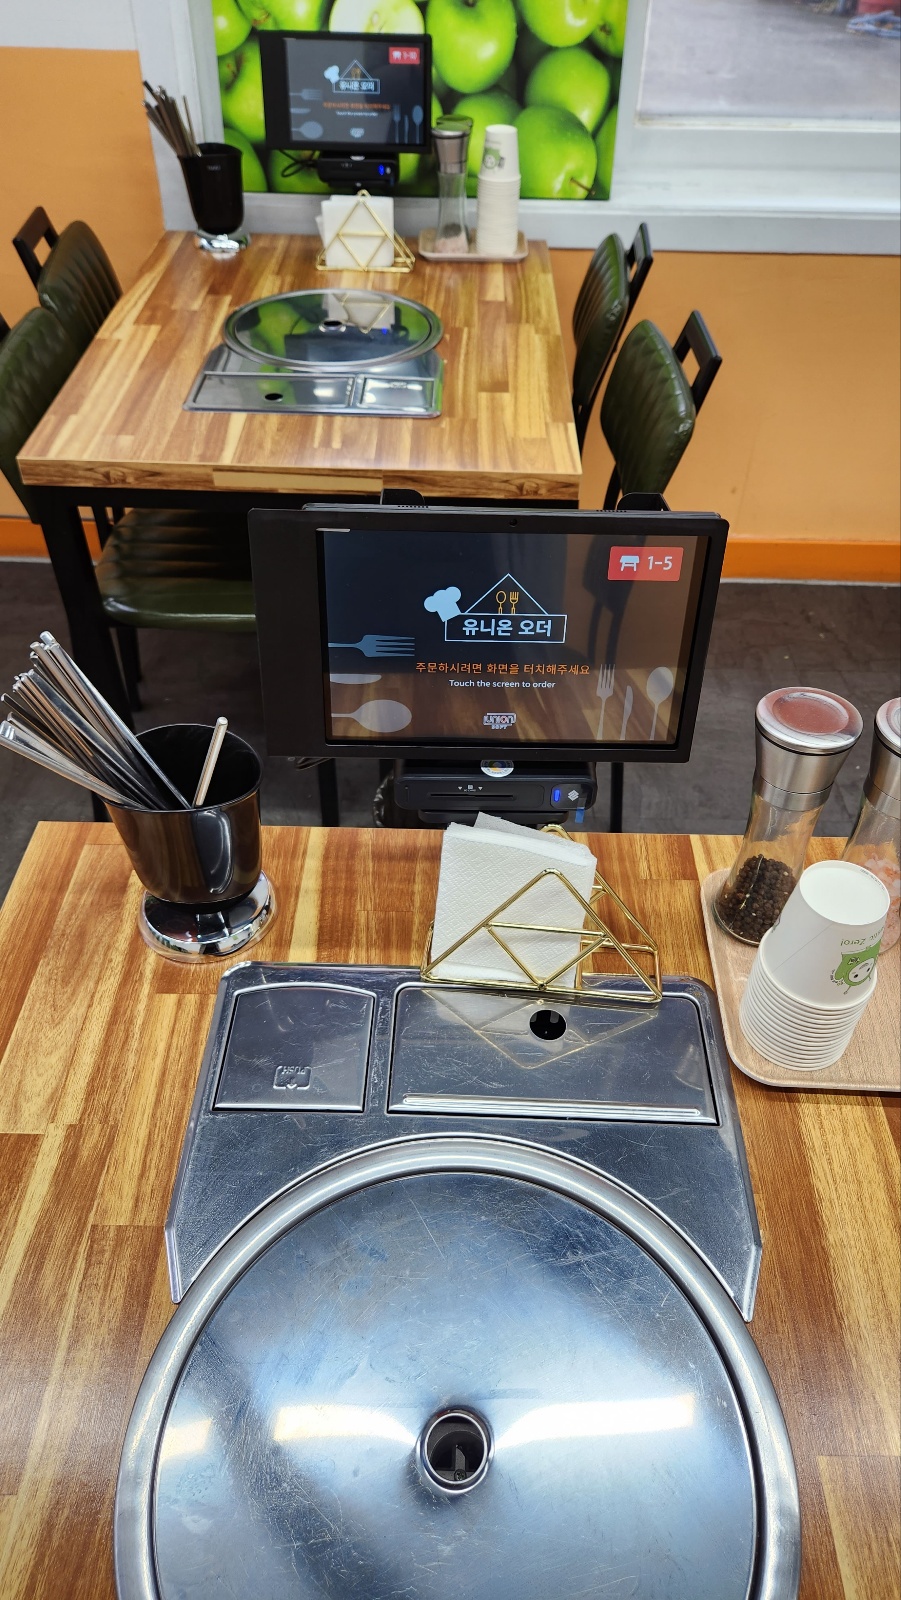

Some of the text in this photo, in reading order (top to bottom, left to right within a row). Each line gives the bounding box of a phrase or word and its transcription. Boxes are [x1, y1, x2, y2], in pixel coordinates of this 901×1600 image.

[647, 555, 673, 571] 1-5
[462, 618, 552, 637] 유니온 오더
[415, 662, 590, 676] 주문하시려면 화면을 터치해주세요
[448, 679, 556, 689] Touch the screen to order
[281, 1065, 306, 1075] PUSH
